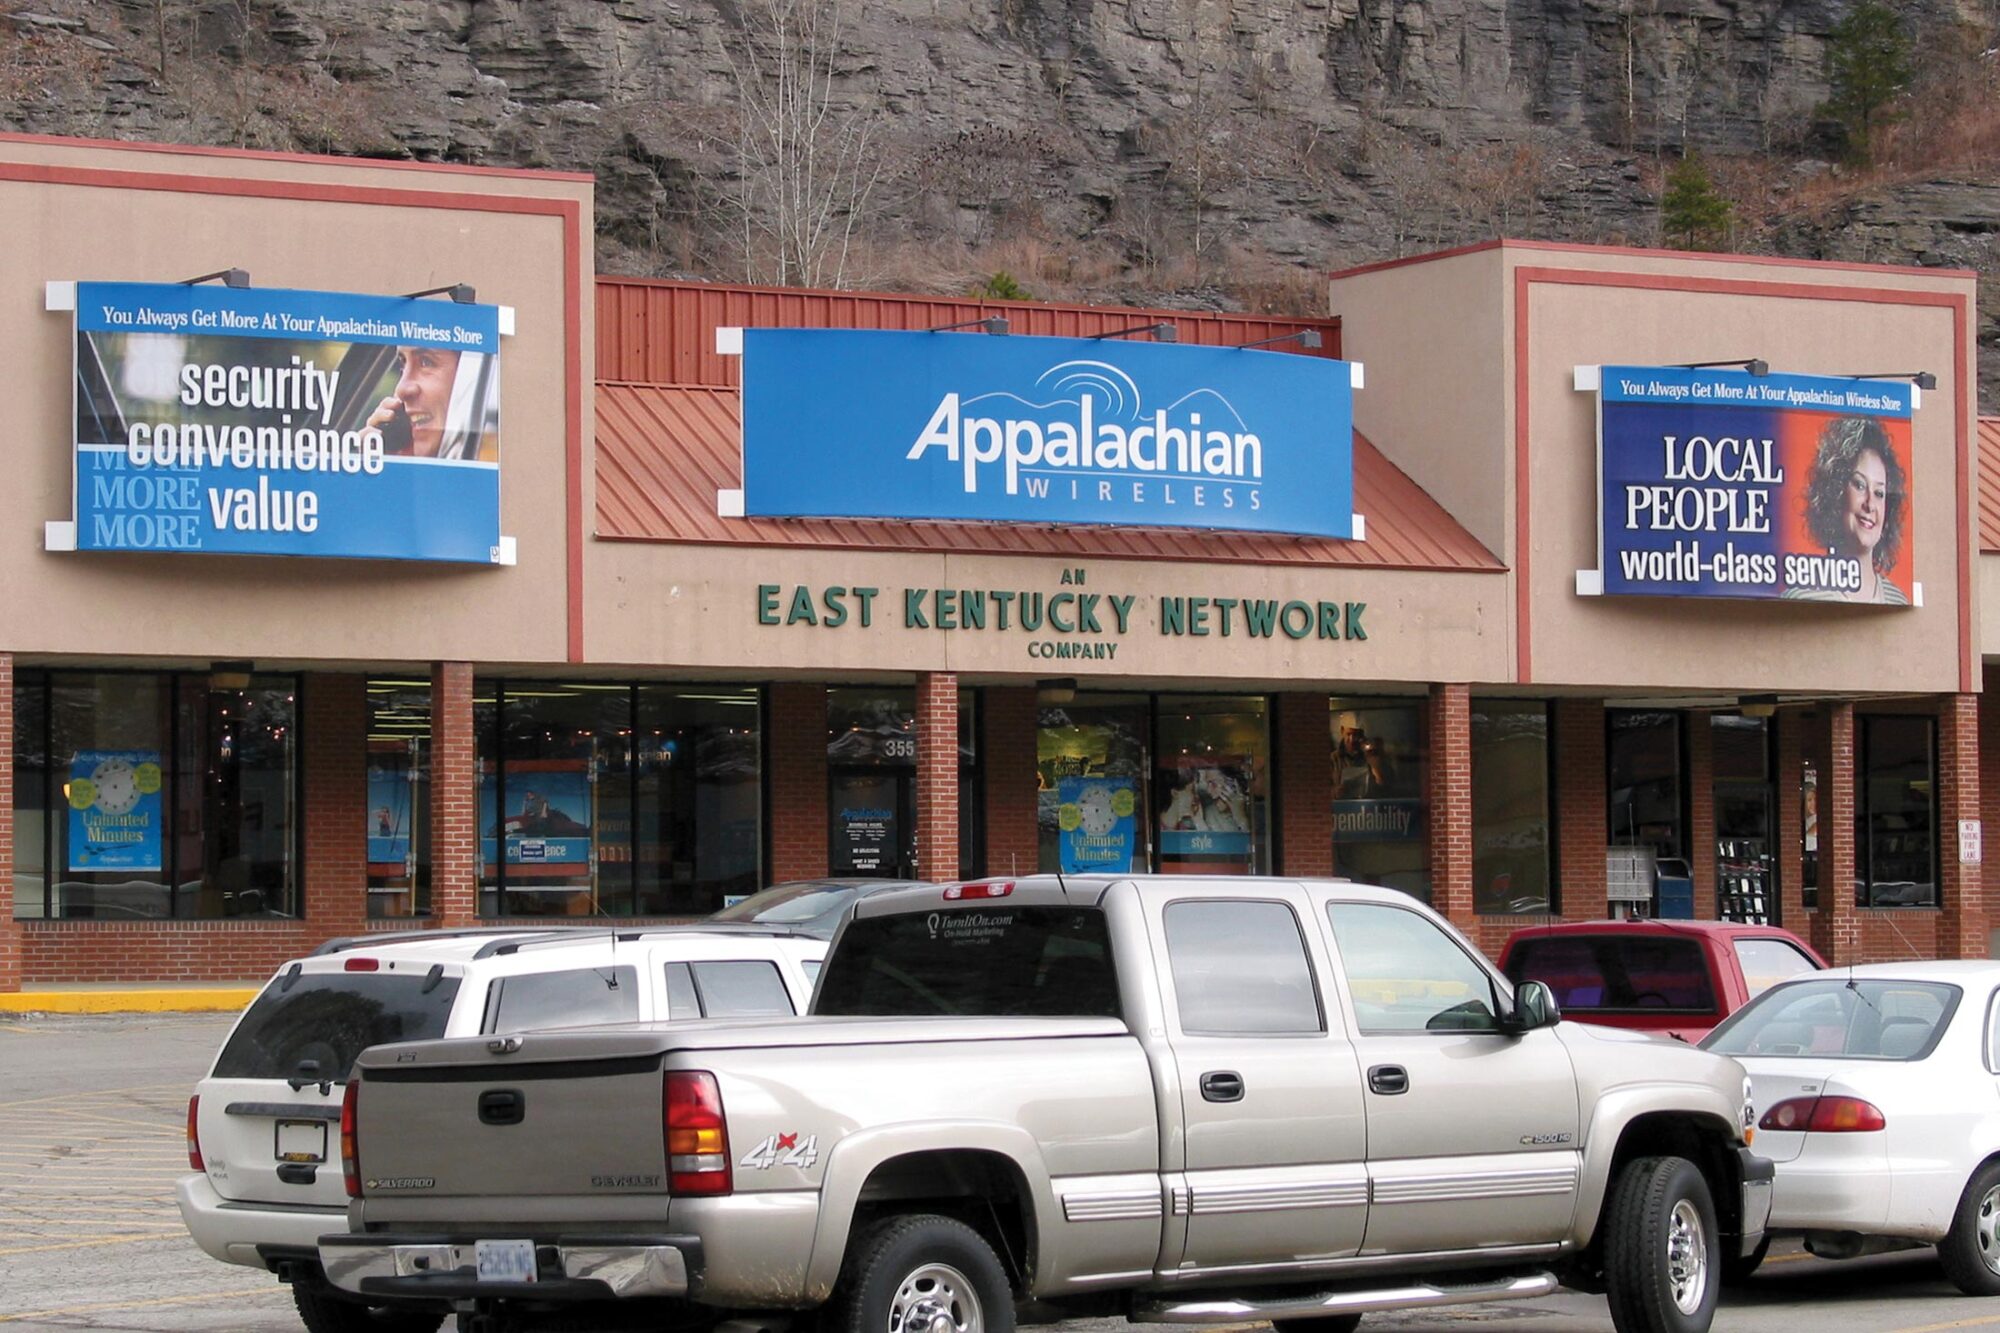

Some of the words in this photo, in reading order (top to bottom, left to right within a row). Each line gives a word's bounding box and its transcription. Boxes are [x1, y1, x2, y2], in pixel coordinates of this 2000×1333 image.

[102, 306, 132, 325] You
[136, 307, 188, 330] Always
[192, 309, 217, 327] Get
[221, 310, 259, 329] More
[261, 312, 277, 330] At
[280, 313, 315, 332] Your
[317, 315, 398, 338] Appalachian
[400, 321, 451, 342] Wireless
[452, 325, 483, 345] Store
[181, 355, 340, 425] security
[1620, 380, 1645, 395] You
[1647, 381, 1689, 400] Always
[1691, 382, 1711, 398] Get
[1714, 383, 1743, 399] More
[1745, 384, 1758, 399] At
[1759, 385, 1786, 401] Your
[1787, 386, 1845, 406] Appalachian
[1846, 391, 1881, 409] Wireless
[1881, 394, 1901, 411] Store
[128, 414, 384, 474] convenience
[905, 392, 1262, 495] Appalachian
[1663, 436, 1783, 483] LOCAL
[92, 475, 201, 511] MORE
[208, 475, 319, 533] value
[1025, 477, 1261, 511] WIRELESS
[1625, 485, 1770, 533] PEOPLE
[92, 514, 202, 548] MORE
[1060, 568, 1086, 586] AN
[1620, 540, 1777, 584] world-class
[1784, 547, 1861, 589] service
[758, 584, 879, 628] EAST
[904, 588, 1137, 634] KENTUCKY
[1160, 596, 1368, 641] NETWORK
[1027, 640, 1118, 660] COMPANY
[885, 740, 914, 757] 355
[83, 811, 149, 827] Unlimited
[87, 826, 144, 842] Minutes
[1070, 833, 1124, 847] Unlimited
[1075, 846, 1121, 861] Minutes
[1191, 834, 1213, 850] style
[942, 914, 1013, 928] TurnItOn.com
[378, 1178, 435, 1189] SILVERADO
[591, 1175, 660, 1187] CHEVROLET
